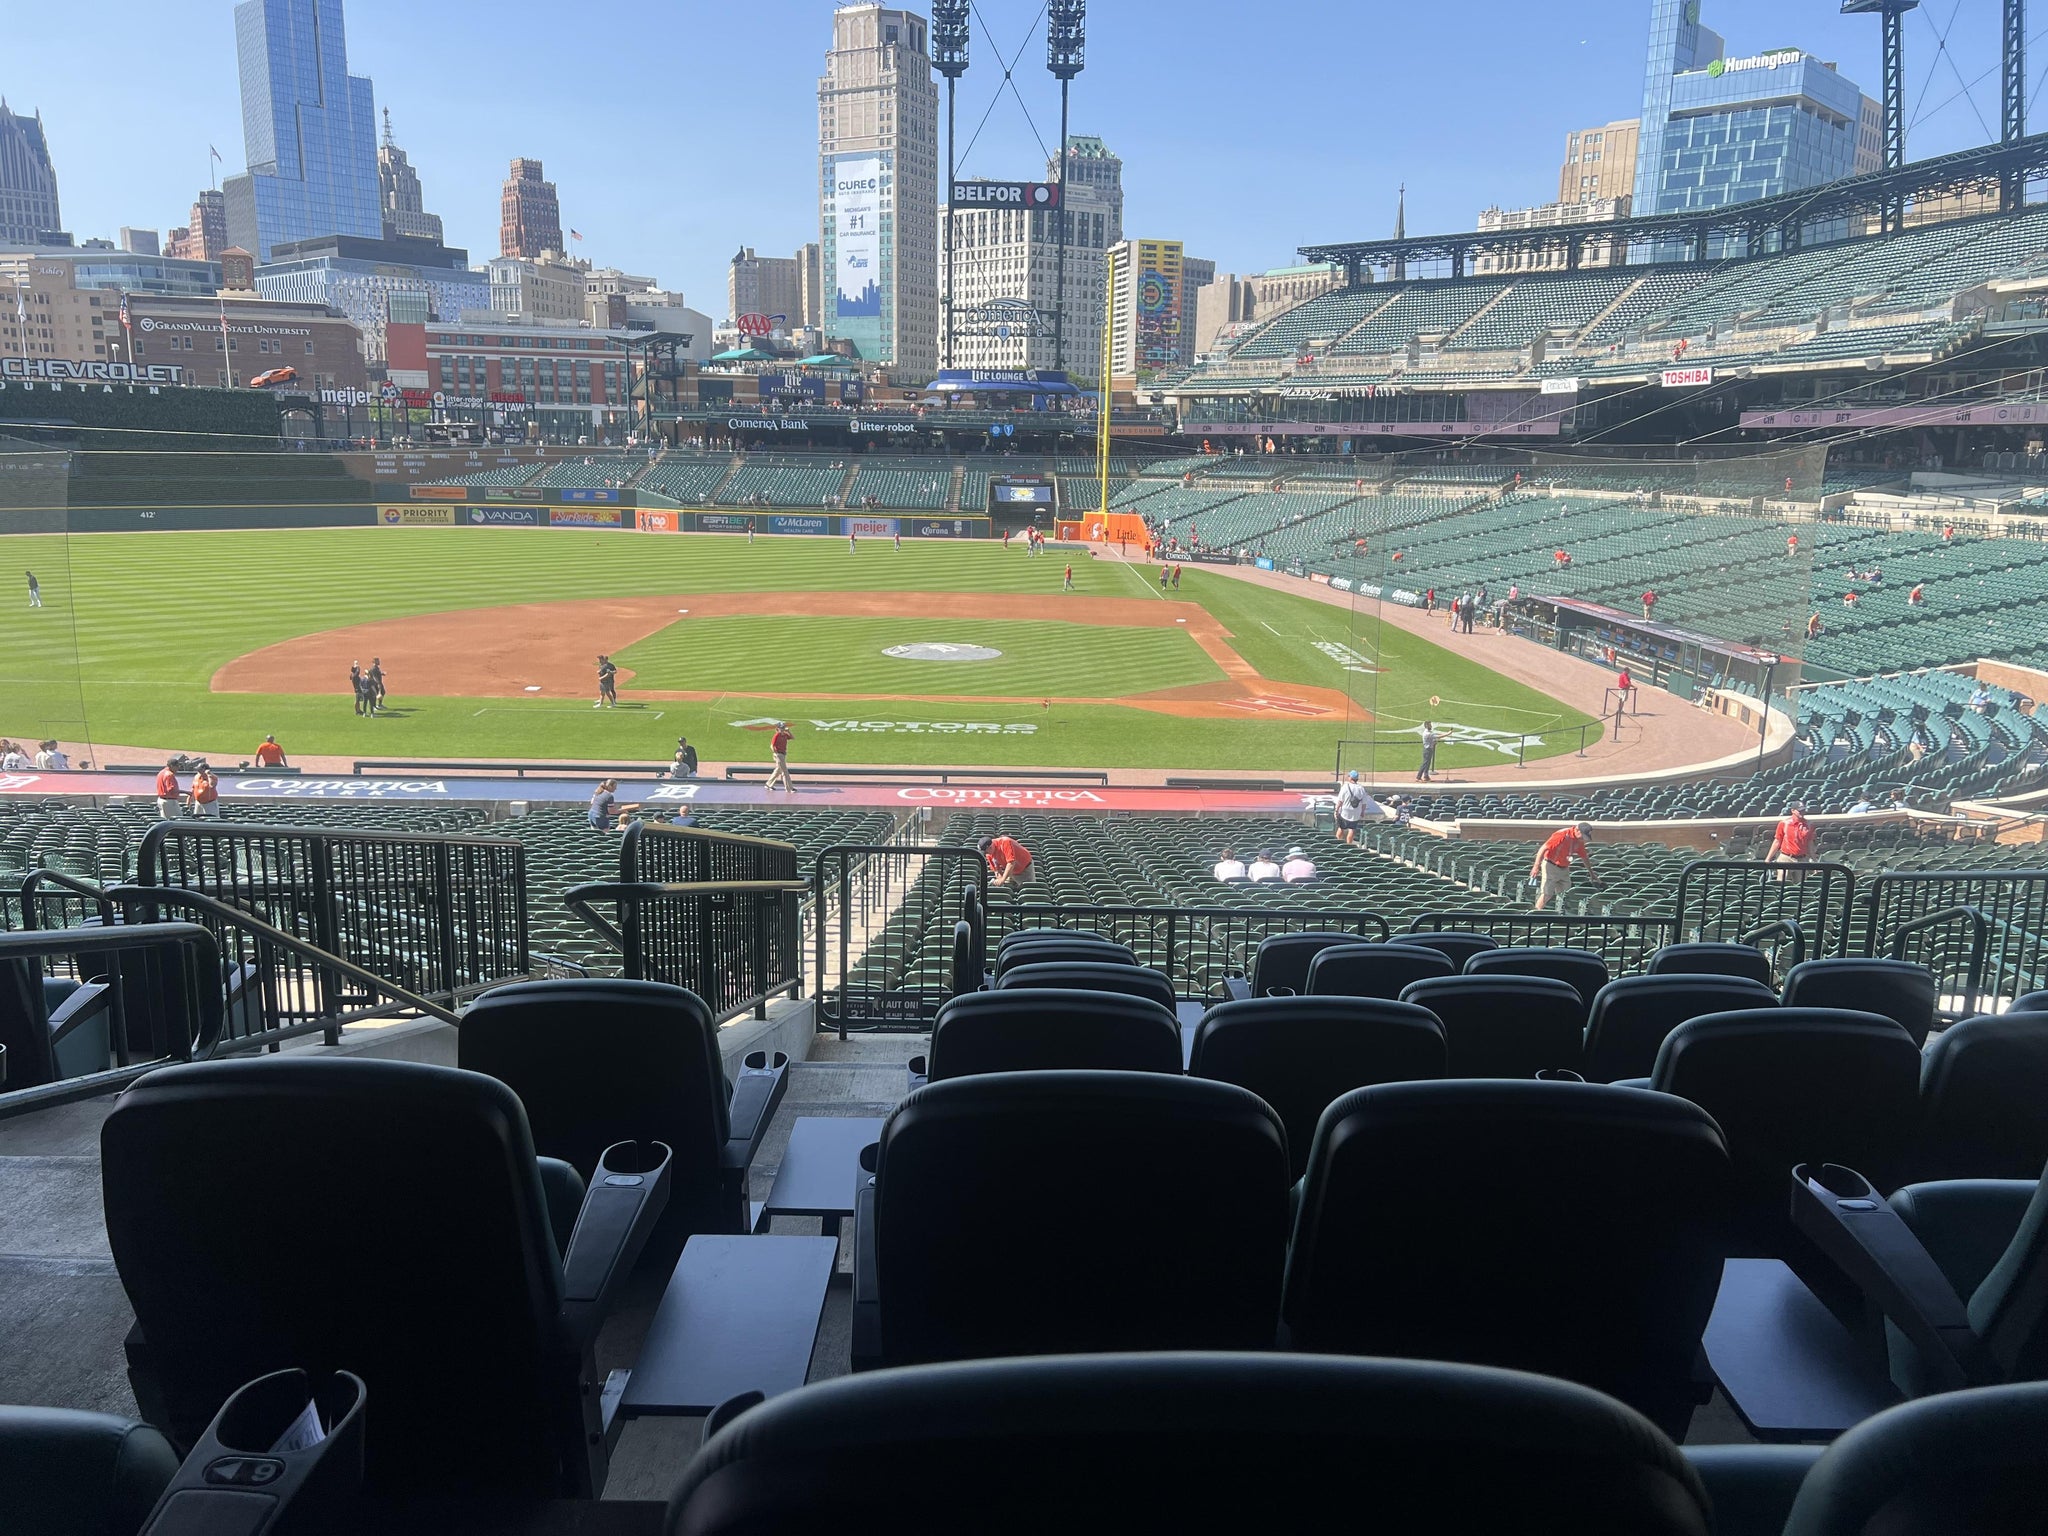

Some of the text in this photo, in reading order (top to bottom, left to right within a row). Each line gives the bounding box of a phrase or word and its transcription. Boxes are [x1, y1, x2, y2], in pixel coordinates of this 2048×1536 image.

[1724, 50, 1800, 73] Huntington
[838, 180, 867, 191] CURE
[954, 185, 1021, 202] BELFOR
[850, 214, 864, 229] #1
[155, 320, 311, 336] GRAND VALLEY STATE UNIVERSITY
[739, 315, 771, 335] AAA
[1, 357, 183, 382] CHEVROLET
[784, 373, 802, 389] Lite
[972, 370, 1023, 382] Lite LOUNGE
[1664, 369, 1709, 385] TOSHIBA
[321, 385, 372, 407] meijer
[770, 386, 801, 394] PITCHER'S
[1340, 387, 1396, 398] TIGER CLUB
[504, 402, 525, 412] LAW
[1836, 413, 1852, 424] DET
[1955, 409, 1972, 422] CIN
[728, 418, 809, 431] Comerica Bank
[1261, 425, 1274, 433] DET
[1314, 425, 1325, 433] CIN
[1381, 424, 1395, 433] DET
[1441, 424, 1454, 432] CIN
[1517, 424, 1533, 433] DET
[468, 450, 478, 460] 10
[503, 448, 511, 456] 11
[535, 448, 545, 456] 42
[403, 509, 448, 518] PRIORITY
[485, 510, 534, 521] VANDA
[555, 511, 595, 523] Surfside
[702, 515, 749, 525] ESPN BET
[787, 518, 822, 527] McLaren
[853, 520, 888, 534] meijer
[921, 526, 949, 536] Corona
[1116, 529, 1137, 541] Little
[809, 718, 1040, 731] VICTORS
[235, 777, 449, 793] Comerica
[897, 787, 1106, 803] Comerica
[881, 1000, 919, 1010] CAUTON!
